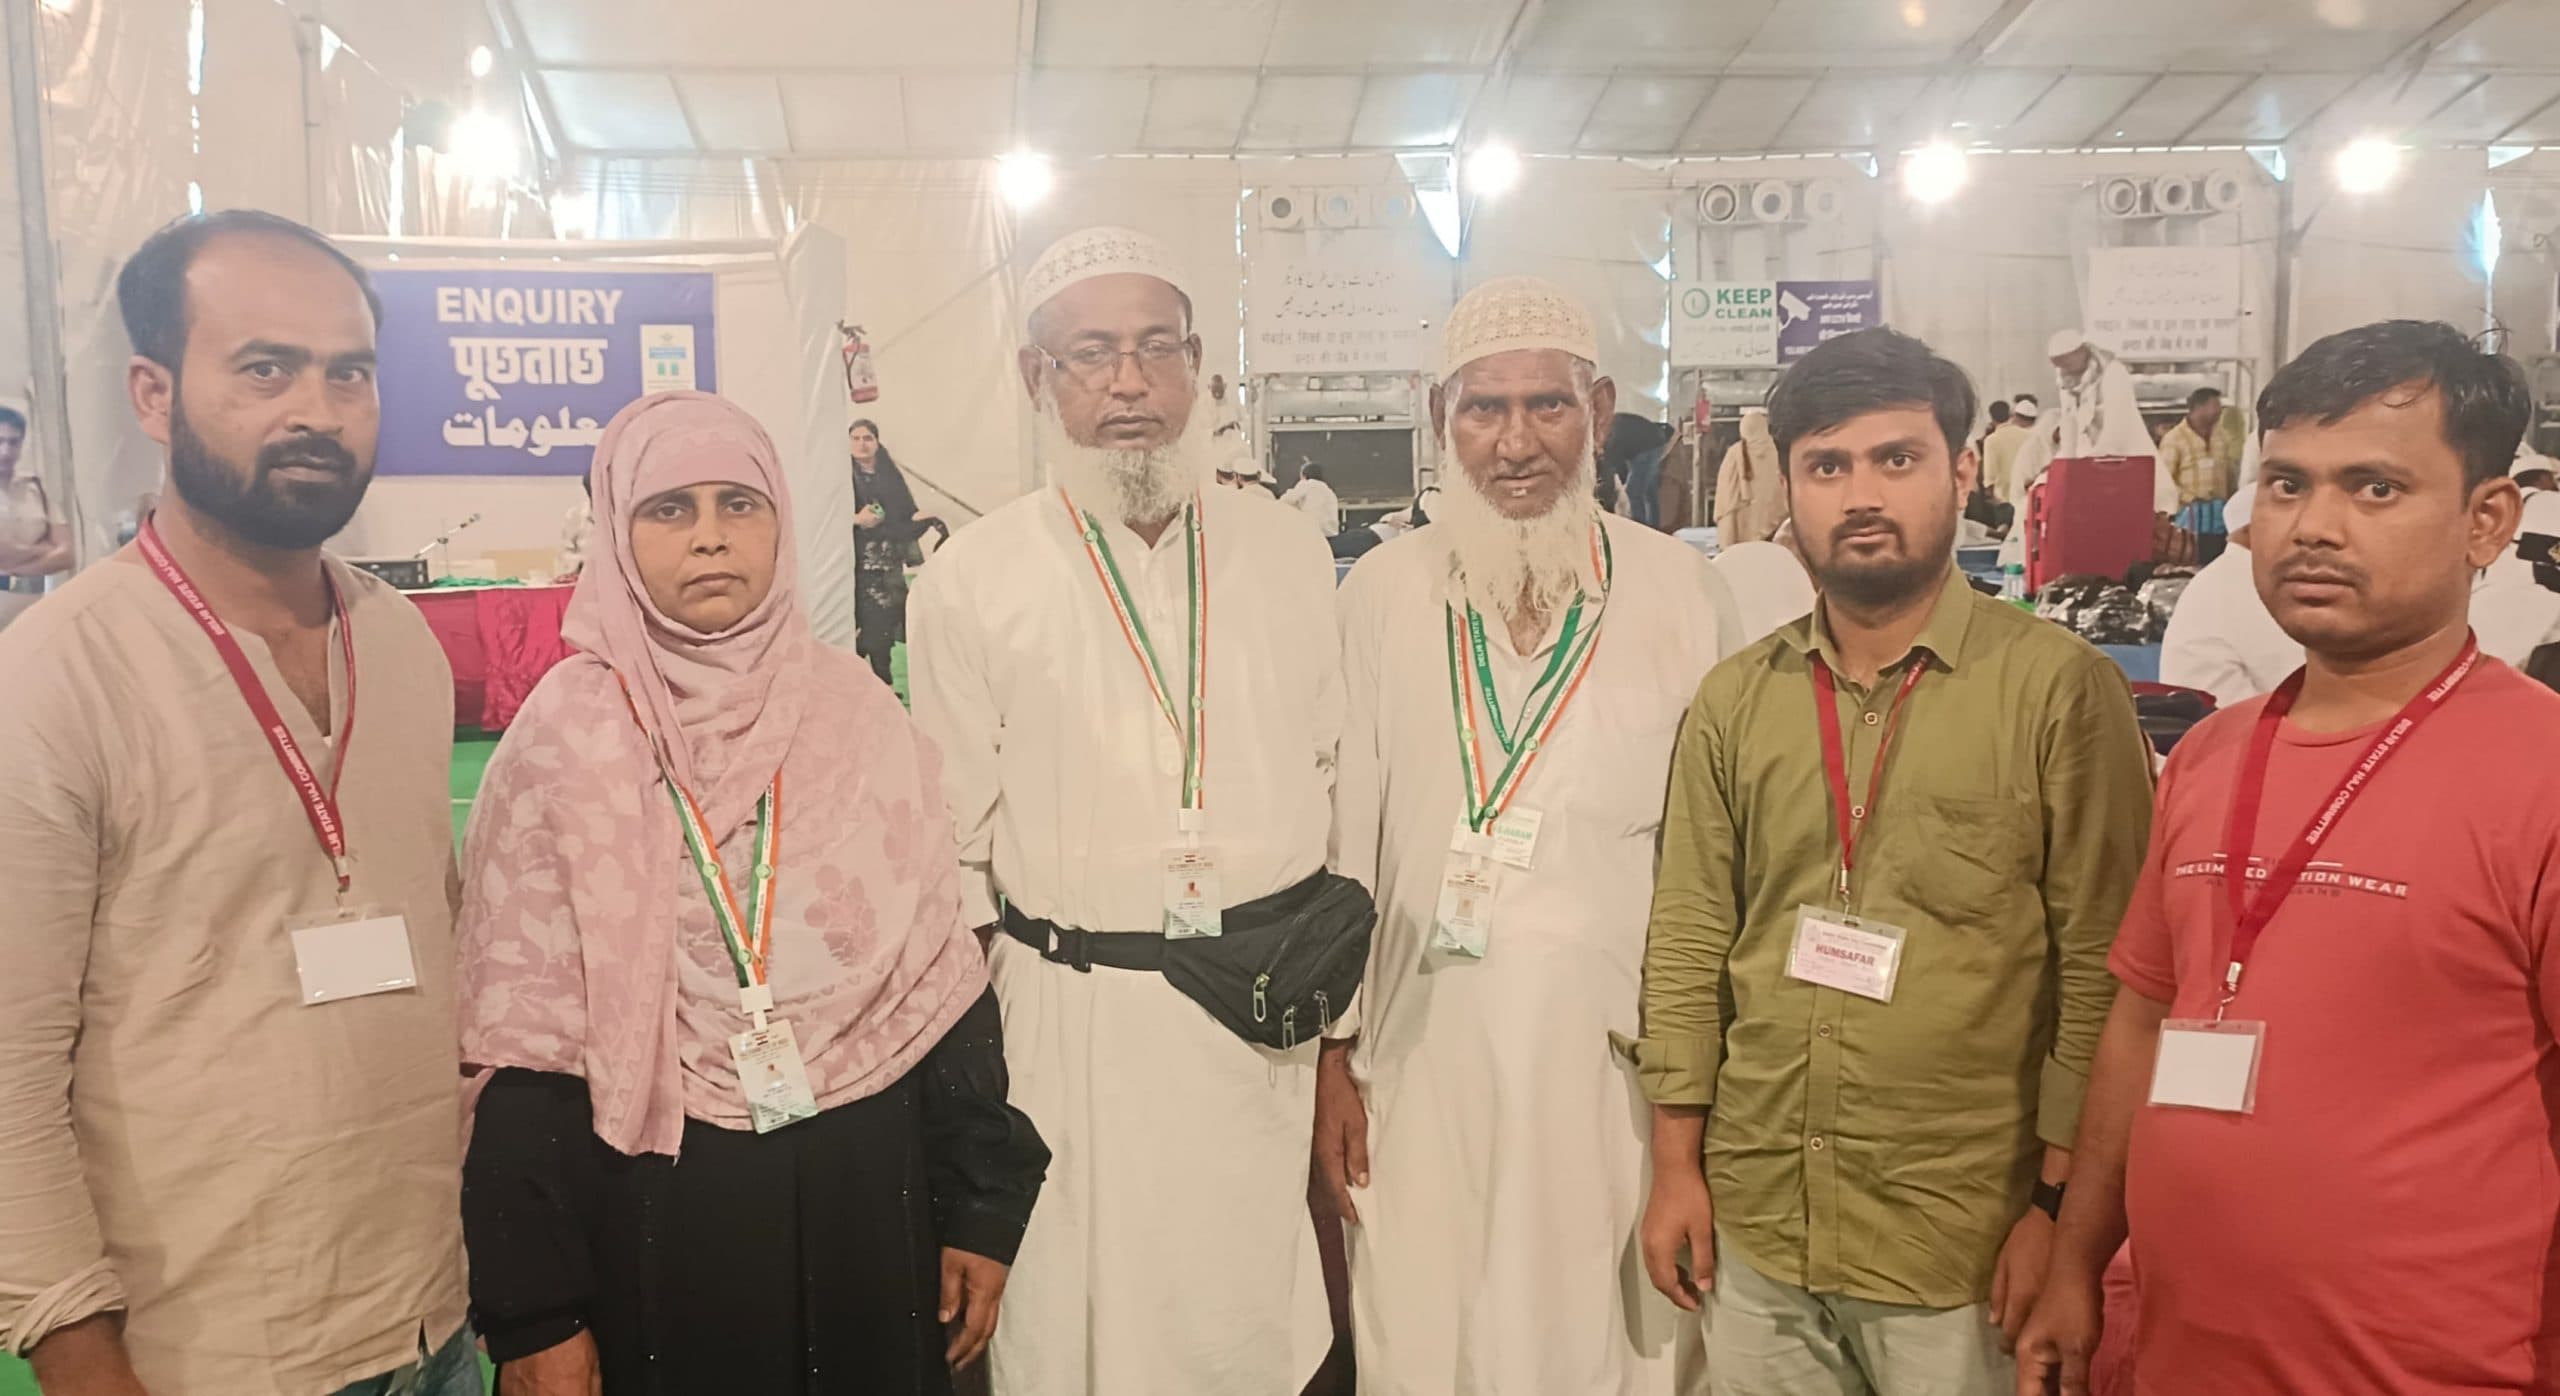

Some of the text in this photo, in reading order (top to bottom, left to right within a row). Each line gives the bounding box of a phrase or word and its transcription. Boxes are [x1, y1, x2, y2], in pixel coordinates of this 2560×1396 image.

[437, 287, 623, 326] ENQUIRY
[1717, 288, 1772, 305] KEEP
[1715, 308, 1772, 320] CLEAN
[448, 337, 608, 401] पूछताछ
[442, 405, 608, 457] علومات
[273, 724, 311, 781] COMMITTEE
[304, 782, 321, 804] HAJ
[2305, 717, 2413, 845] DELHI STATE HAJ COMMITTEE
[314, 801, 335, 834] STATE
[2197, 863, 2267, 879] LIMED
[2348, 874, 2408, 897] WEAR
[1815, 943, 1876, 967] HUMSAFAR
